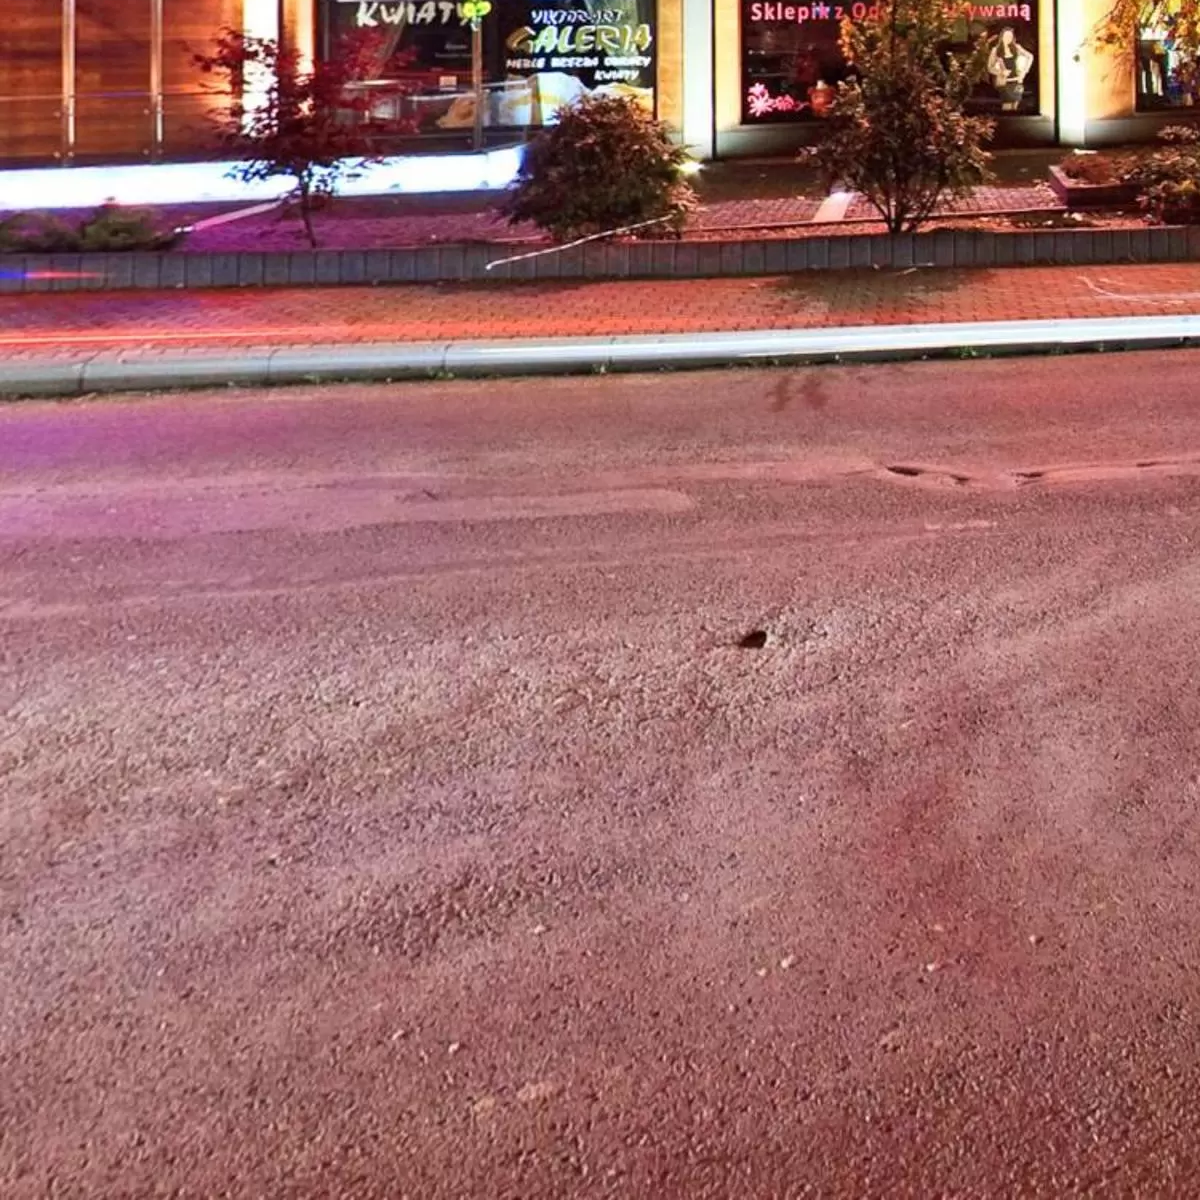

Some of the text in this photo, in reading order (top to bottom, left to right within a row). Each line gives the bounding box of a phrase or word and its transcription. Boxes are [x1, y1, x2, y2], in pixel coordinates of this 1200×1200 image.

[751, 2, 830, 22] Sklepik
[834, 8, 844, 19] z
[507, 24, 652, 54] GALERIA
